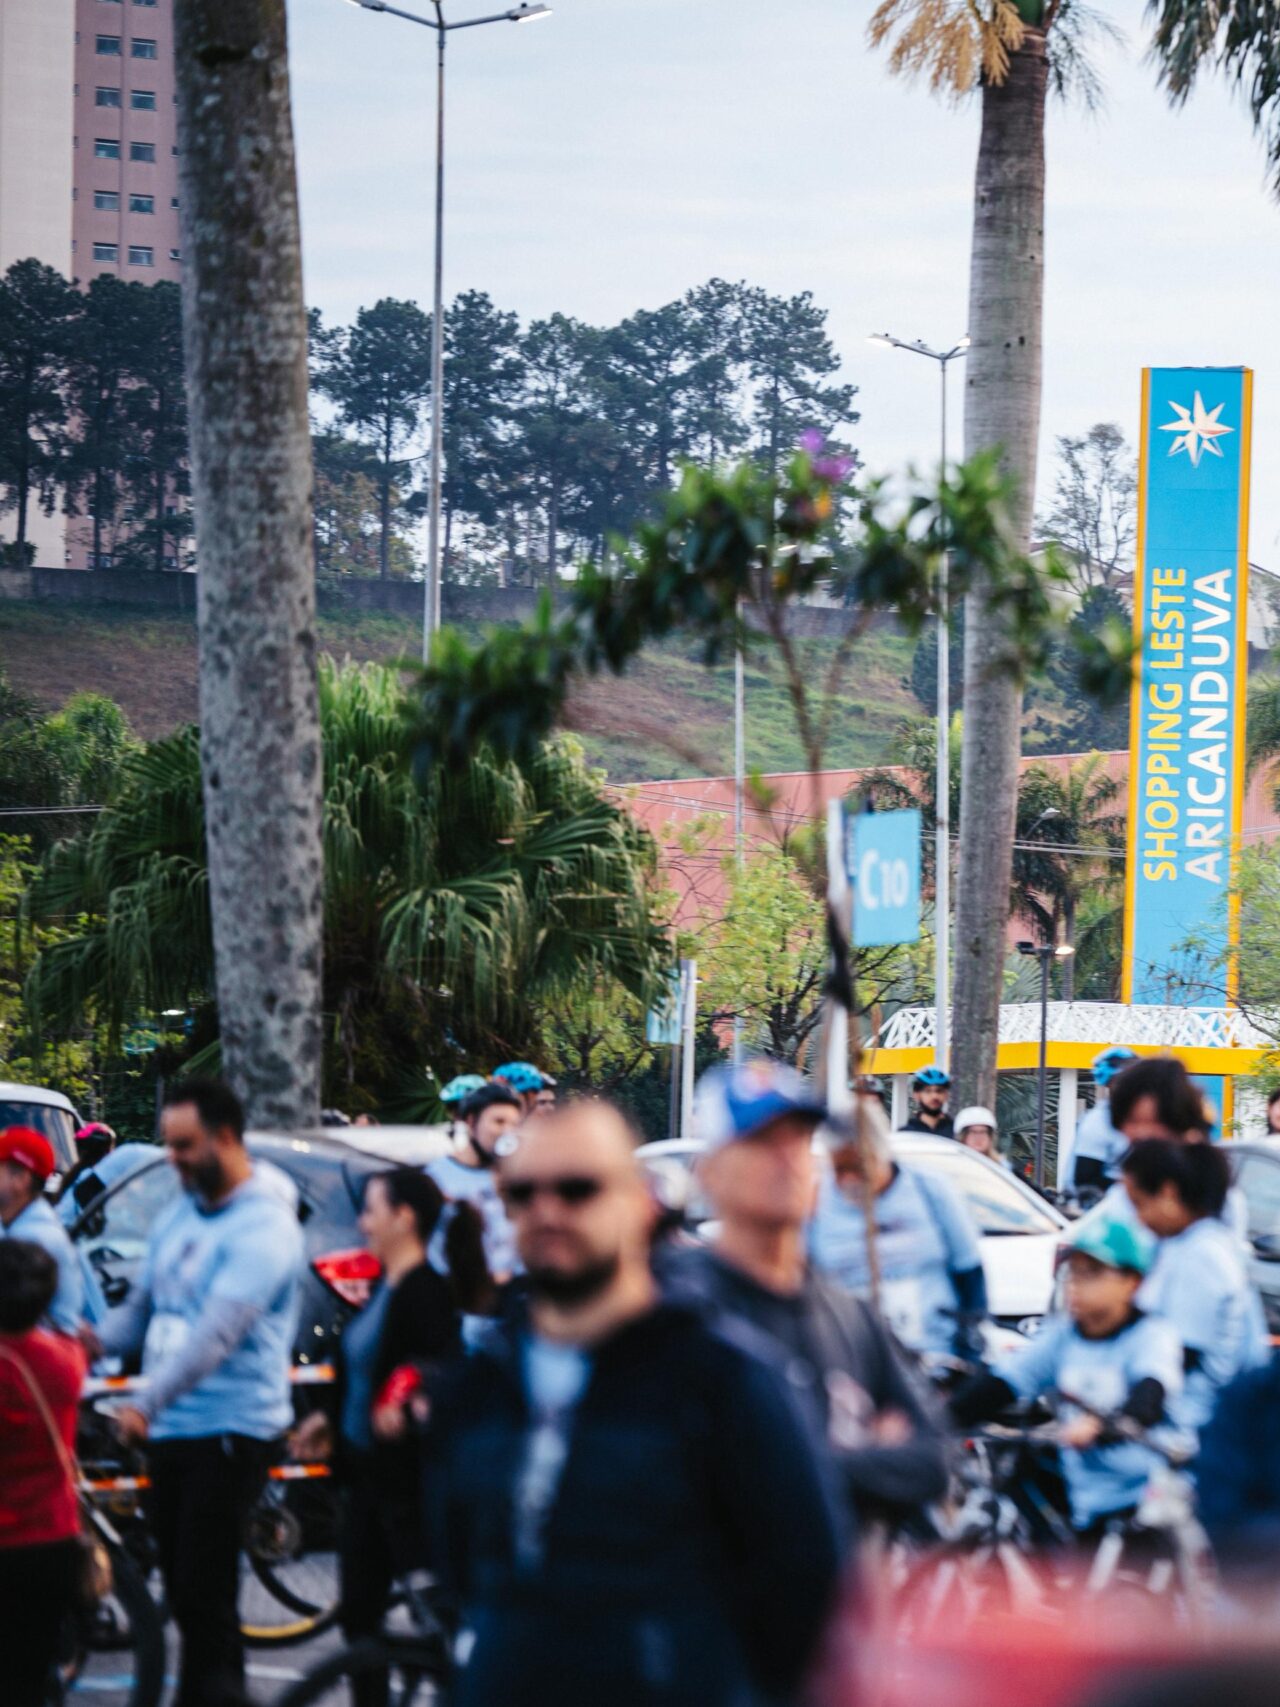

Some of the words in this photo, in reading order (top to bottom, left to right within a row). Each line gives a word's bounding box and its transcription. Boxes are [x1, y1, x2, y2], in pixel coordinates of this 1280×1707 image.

[1150, 568, 1186, 668] LESTE
[1143, 683, 1183, 881] SHOPPING
[1184, 568, 1233, 884] ARICANDUVA
[860, 848, 910, 910] C10
